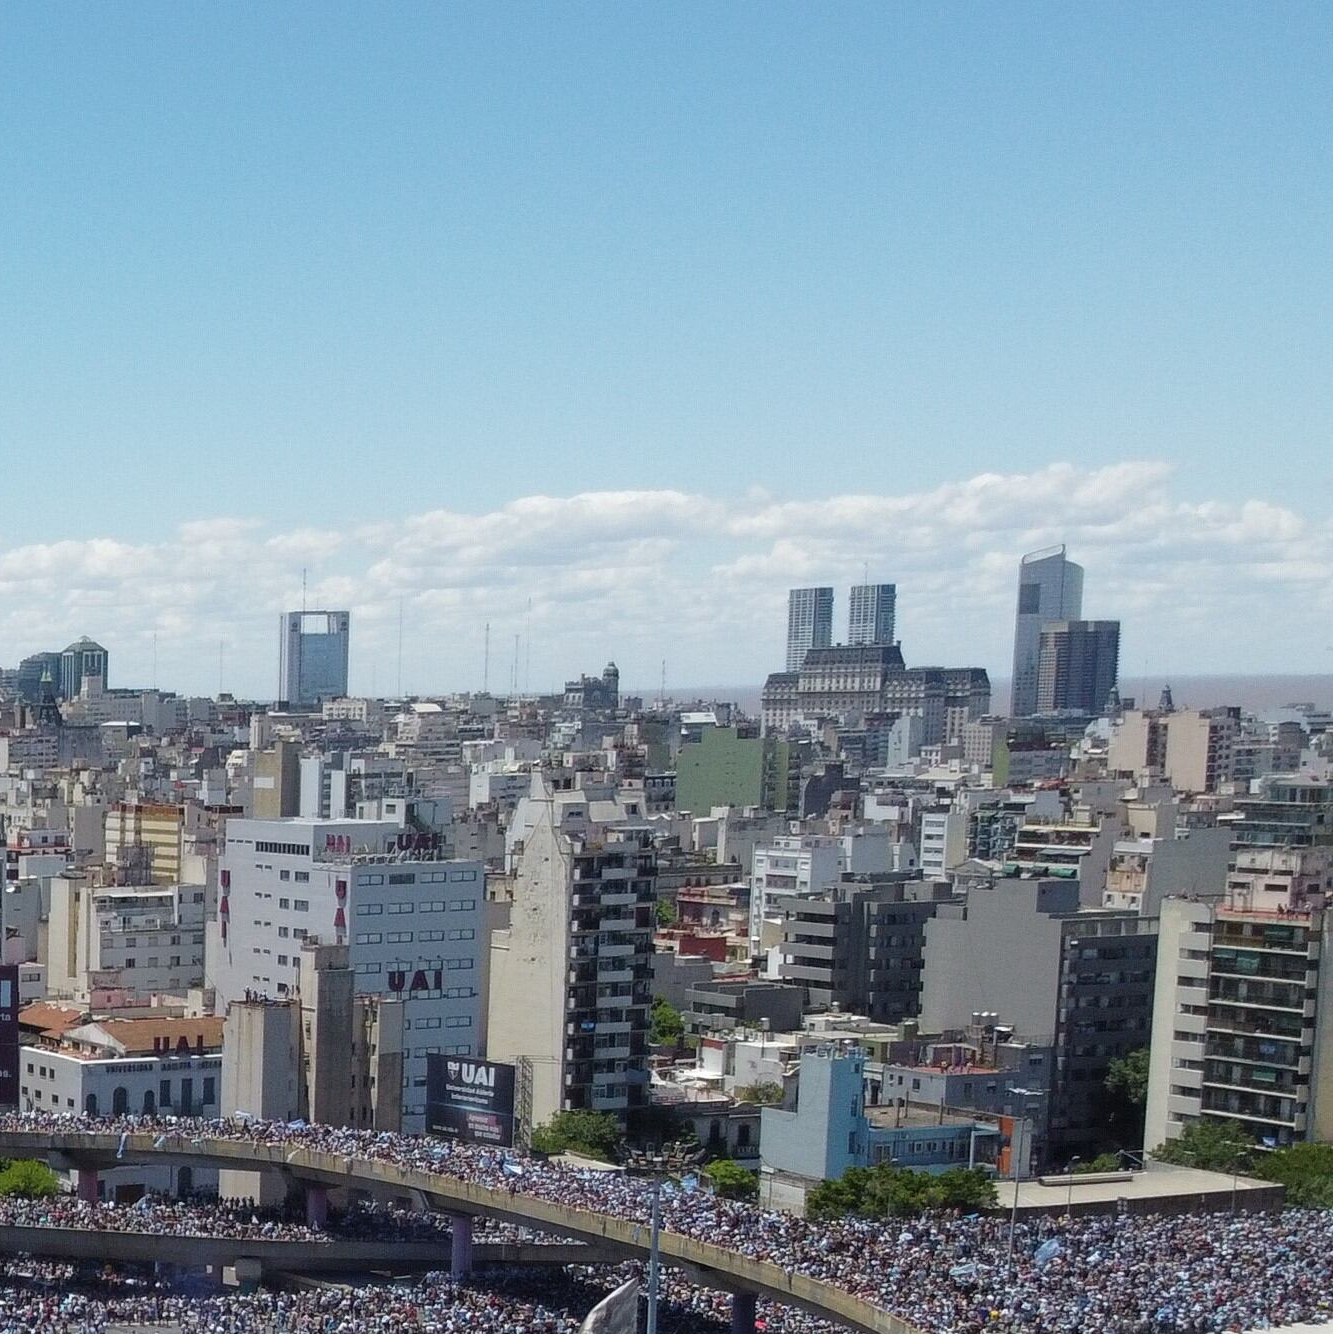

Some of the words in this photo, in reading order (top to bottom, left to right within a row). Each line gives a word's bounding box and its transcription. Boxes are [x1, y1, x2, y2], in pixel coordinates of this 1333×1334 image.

[397, 833, 438, 850] UAI
[388, 970, 443, 992] UAI
[154, 1035, 203, 1056] UAI
[462, 1063, 495, 1087] UAI
